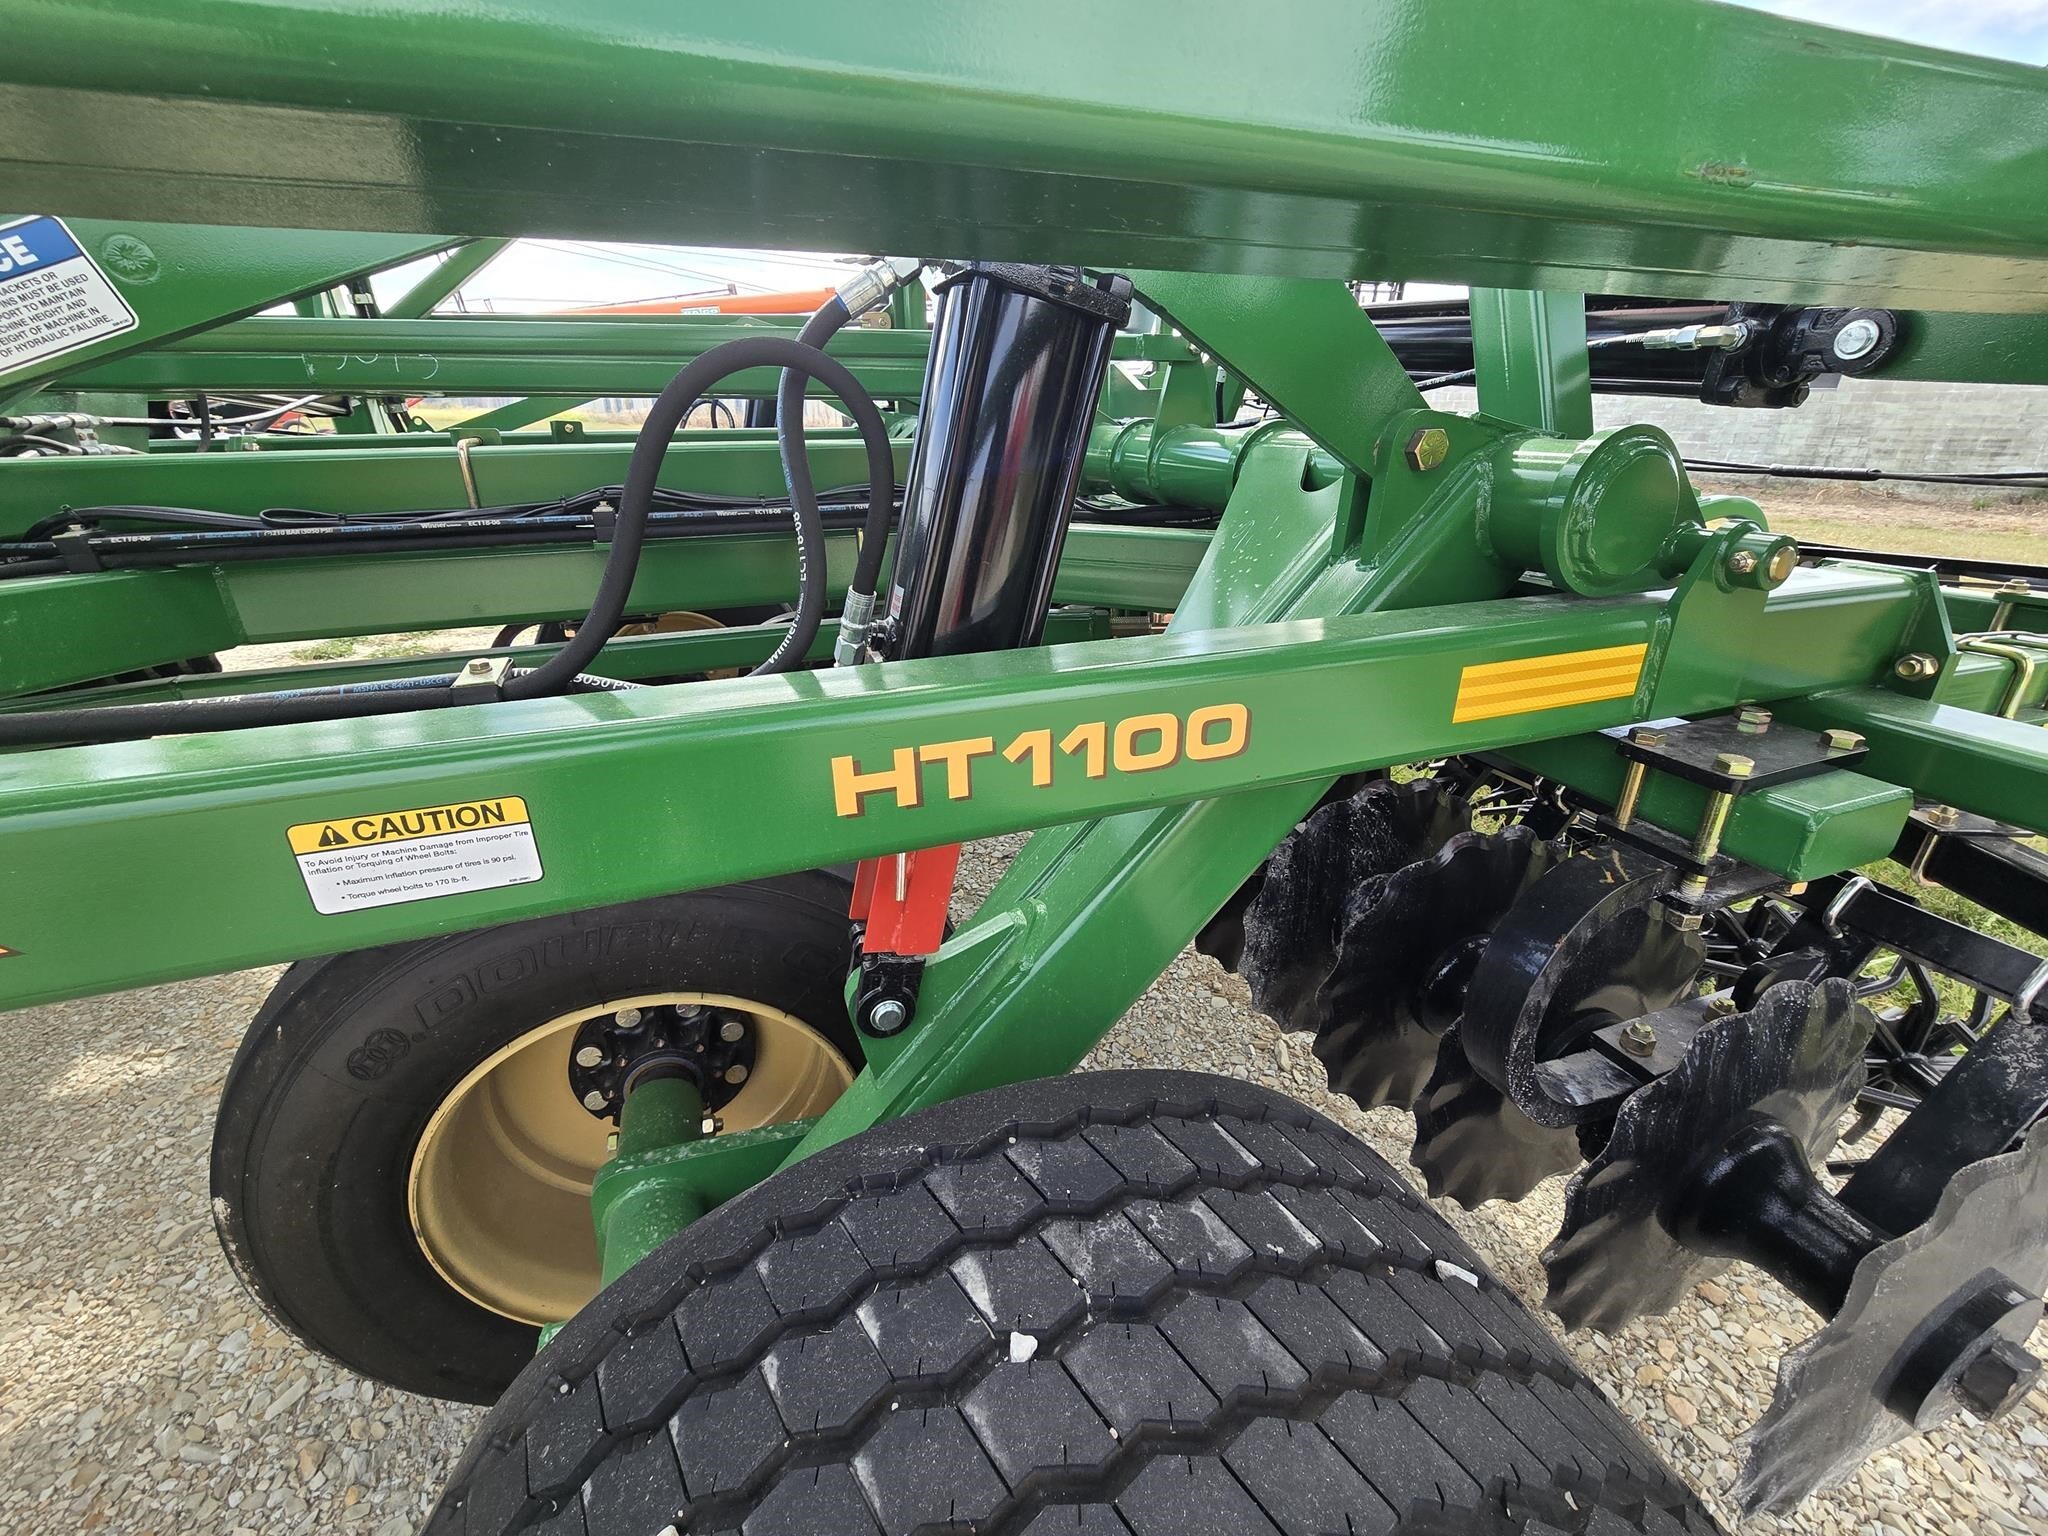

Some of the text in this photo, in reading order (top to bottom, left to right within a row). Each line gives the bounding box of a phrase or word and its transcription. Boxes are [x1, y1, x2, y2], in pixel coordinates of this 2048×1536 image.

[17, 287, 46, 302] MUST
[46, 282, 62, 293] BE
[61, 273, 89, 288] USED
[41, 271, 58, 283] OR
[23, 302, 39, 313] TO
[38, 287, 87, 308] MAINTAIN
[0, 298, 87, 334] CHINE HEIGHT AND
[29, 324, 43, 335] OF
[43, 310, 89, 330] MACHINE
[87, 306, 100, 316] IN
[0, 347, 14, 358] OF
[14, 329, 70, 353] HYDRAULIC
[69, 314, 113, 334] FAILURE.
[831, 703, 1252, 819] HT1100
[351, 802, 506, 842] CAUTION
[318, 856, 343, 866] Avoid
[345, 854, 369, 863] Injury
[381, 847, 418, 857] Machine
[419, 841, 454, 852] Damage
[455, 837, 474, 846] from
[475, 832, 512, 843] Improper
[514, 830, 529, 838] Tire
[355, 858, 394, 870] Torquing
[405, 851, 431, 861] Wheel
[433, 849, 458, 858] Bolts:
[342, 875, 384, 886] Maximum
[385, 870, 418, 879] inflation
[419, 865, 454, 876] pressure
[464, 859, 482, 867] tires
[483, 857, 490, 865] is
[347, 891, 376, 900] Torque
[377, 885, 402, 895] wheel
[403, 882, 424, 892] bolts
[435, 878, 450, 887] 170
